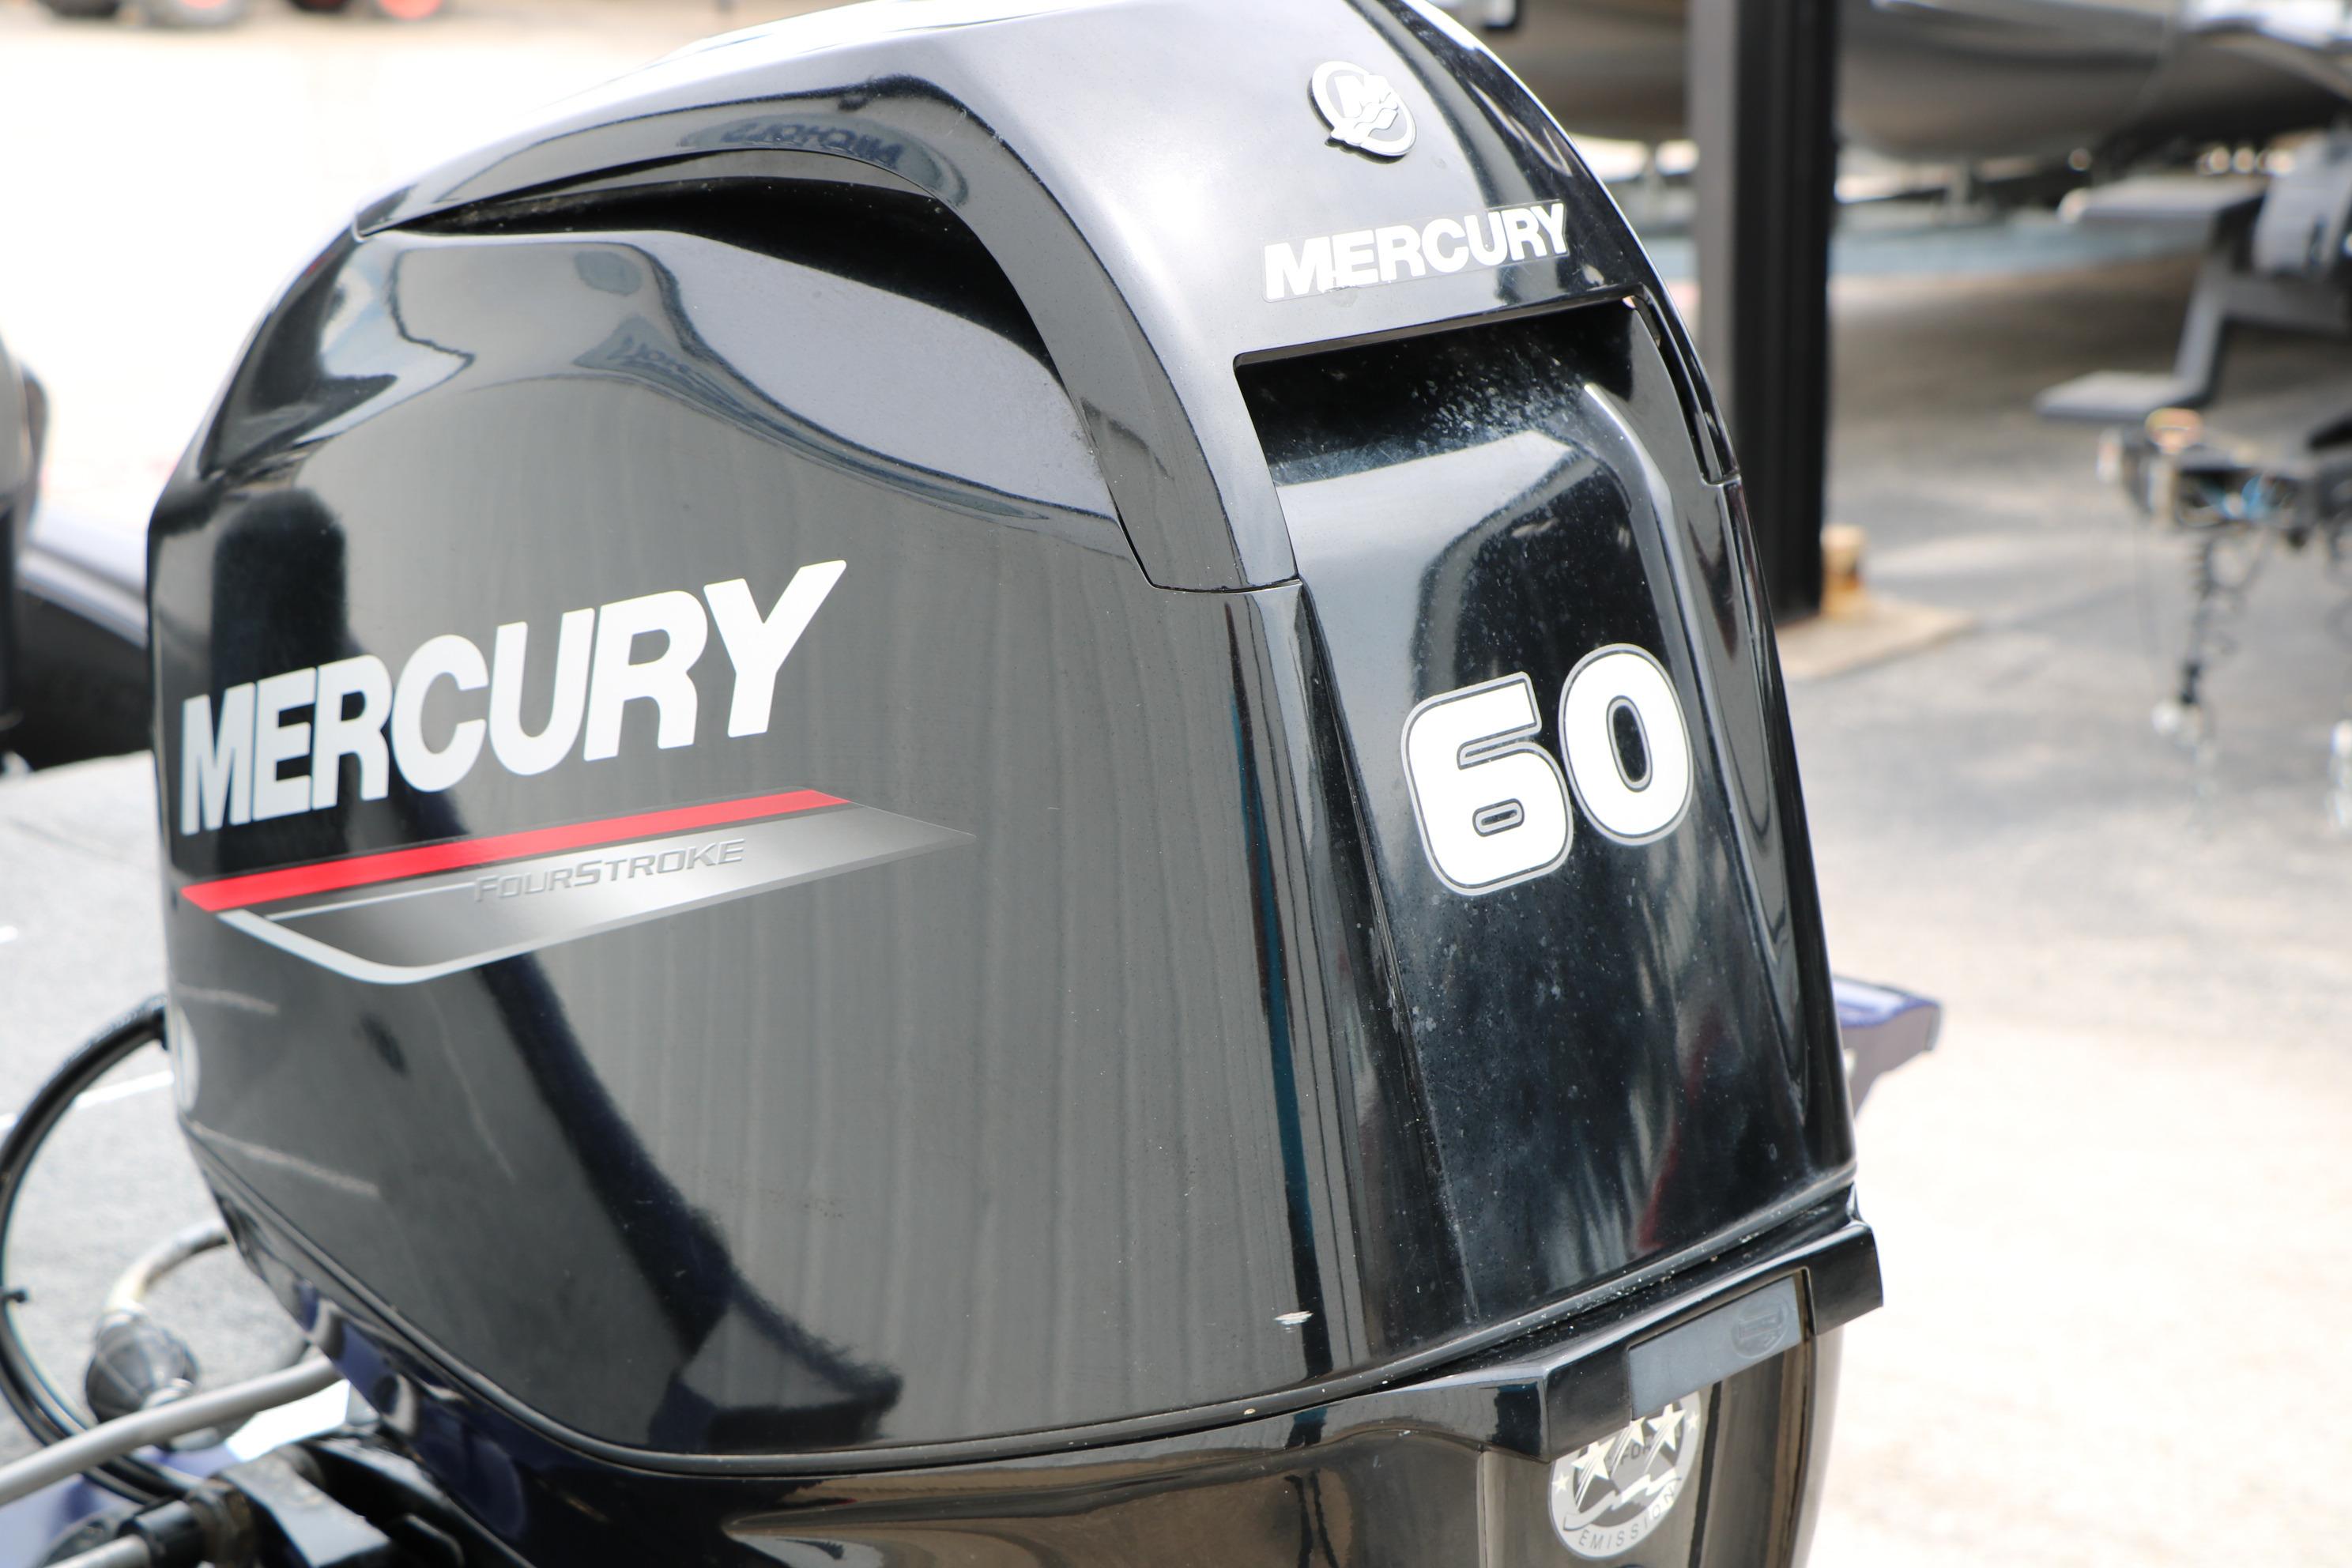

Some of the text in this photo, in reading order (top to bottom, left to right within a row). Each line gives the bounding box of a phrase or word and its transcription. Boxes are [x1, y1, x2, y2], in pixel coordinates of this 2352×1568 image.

[1265, 203, 1568, 300] MERCURY
[181, 560, 846, 836] MERCURY
[1400, 643, 1694, 896] 60
